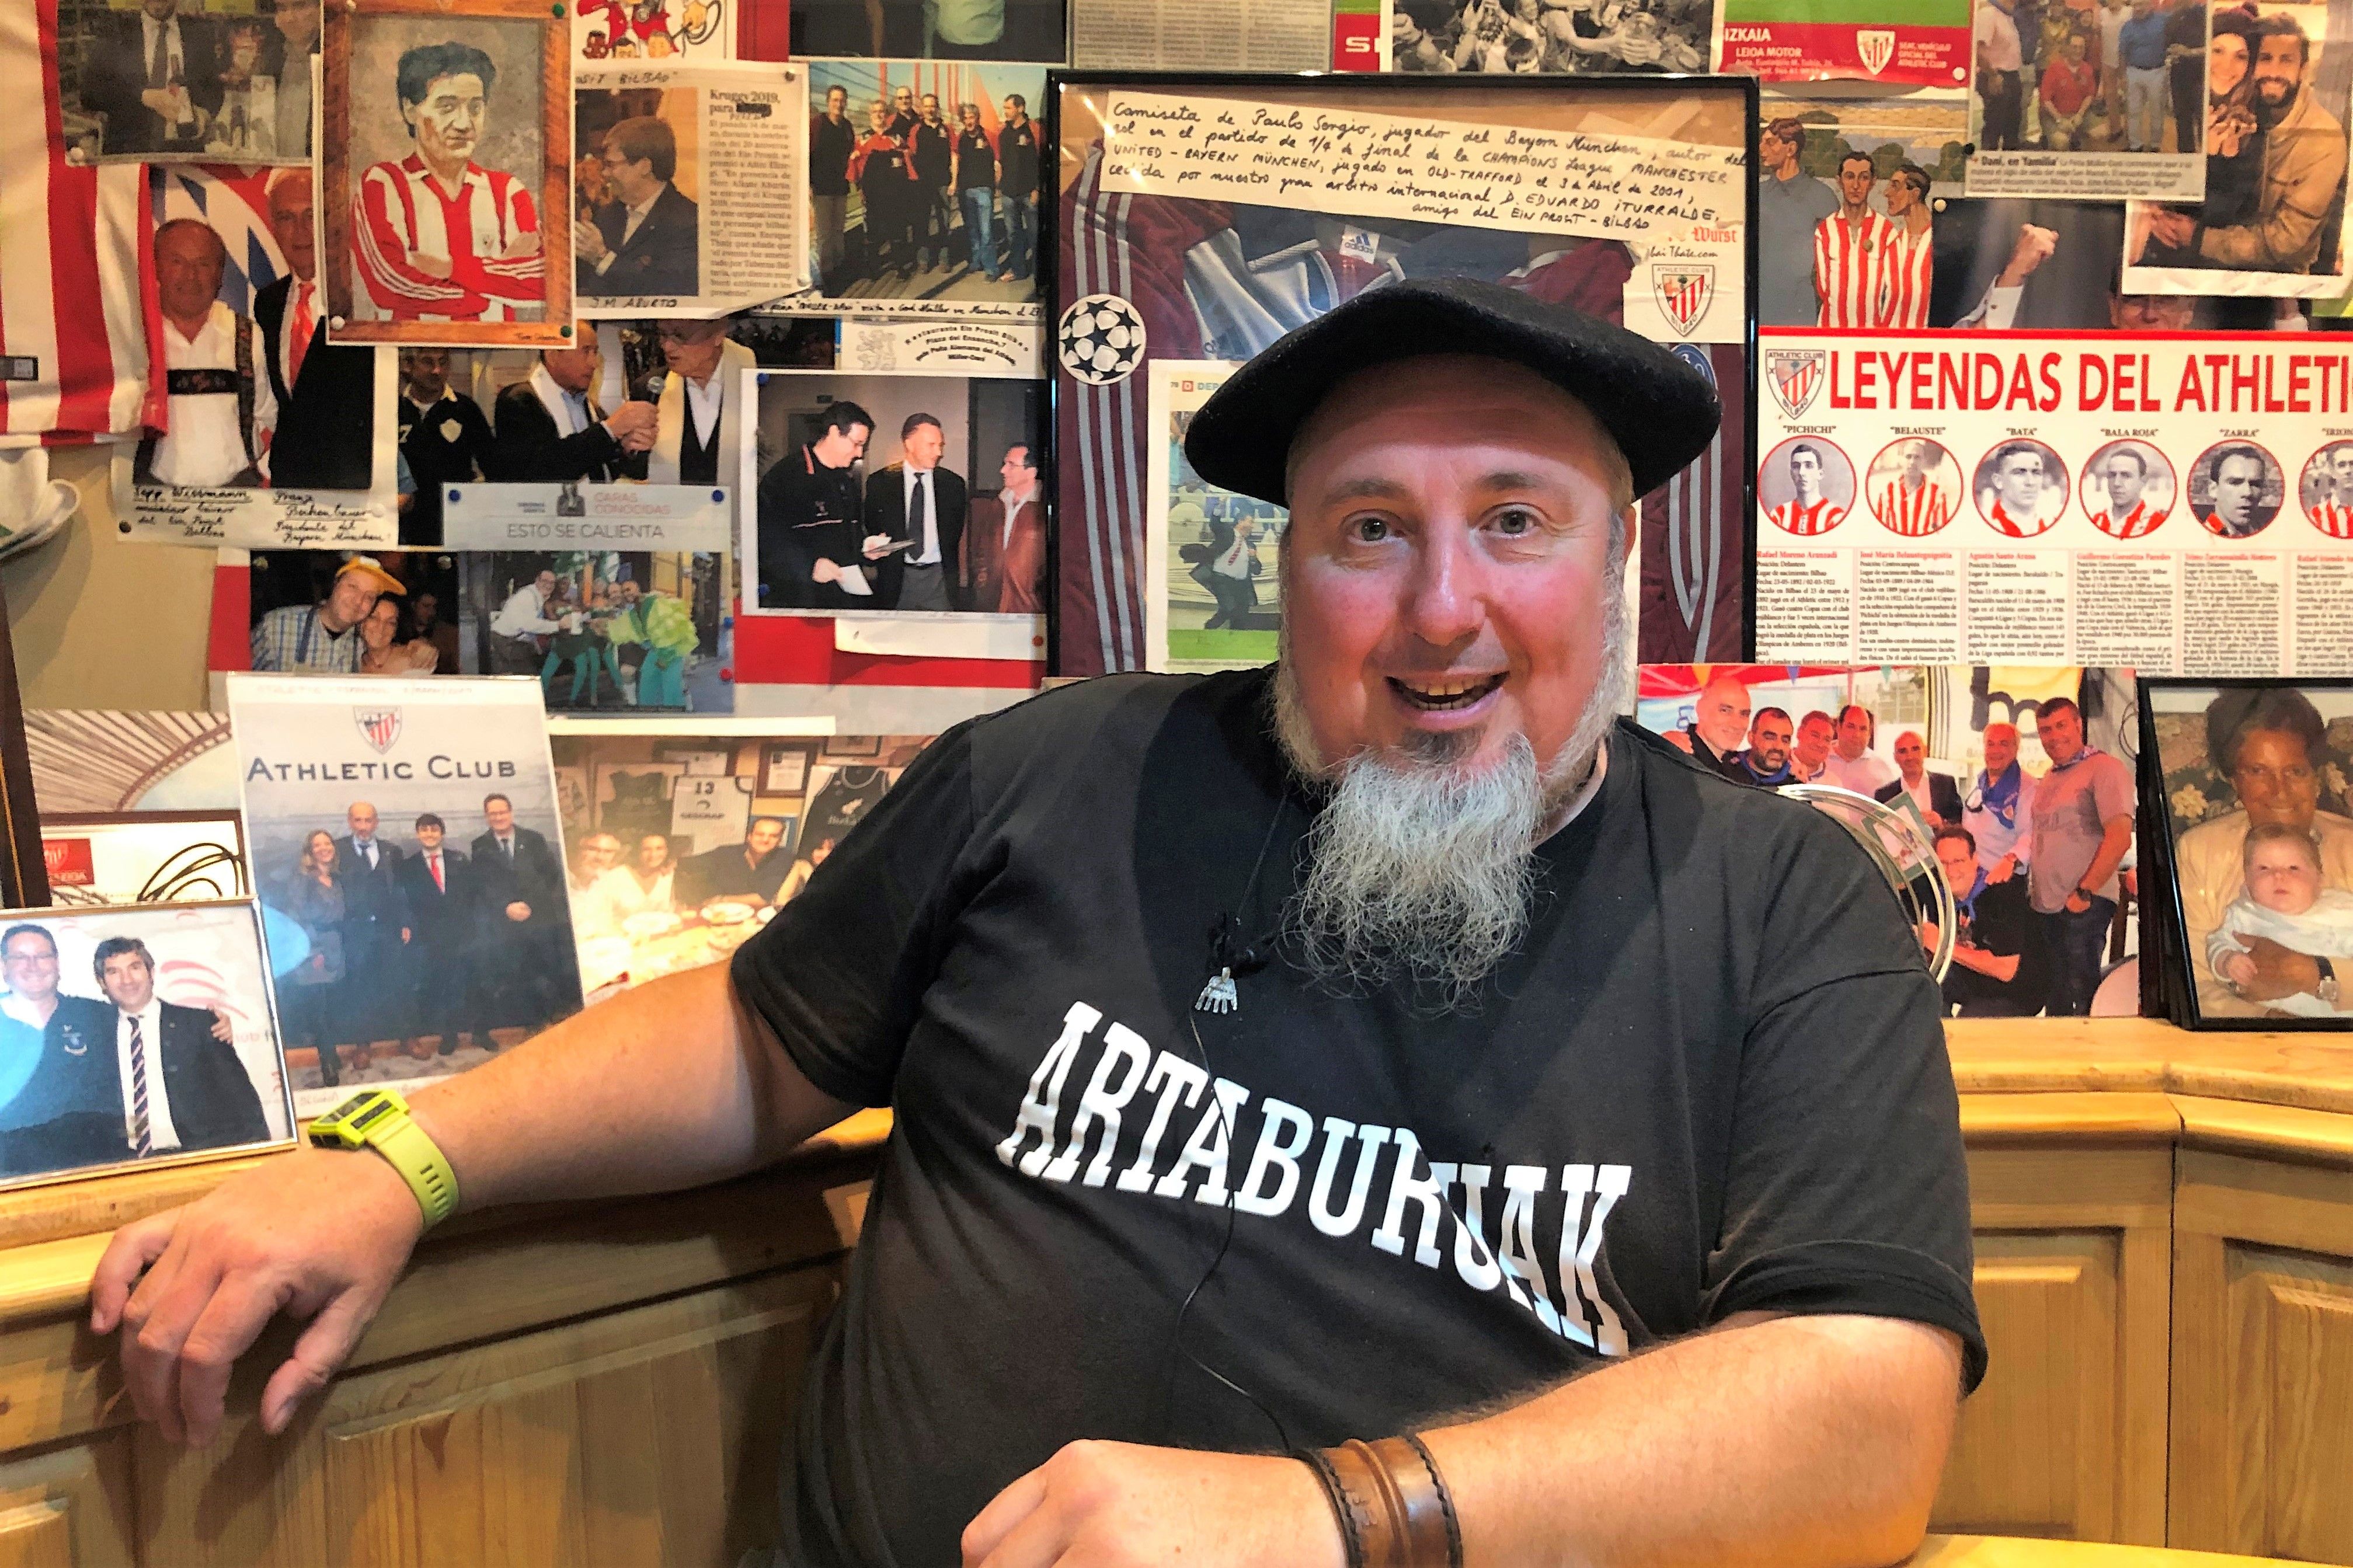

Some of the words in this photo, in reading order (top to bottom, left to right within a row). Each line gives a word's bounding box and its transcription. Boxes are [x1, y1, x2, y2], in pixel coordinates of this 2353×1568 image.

[1725, 28, 1771, 41] IZKAIA
[1345, 37, 1380, 53] S
[1736, 47, 1764, 57] LEIOA
[1767, 48, 1802, 57] MOTOR
[1113, 102, 1201, 122] Camiseta
[1217, 110, 1235, 124] de
[1252, 108, 1303, 130] Paulo
[1383, 124, 1450, 143] jugador
[1462, 129, 1489, 143] del
[1665, 146, 1711, 161] autor
[1150, 128, 1166, 137] en
[1179, 125, 1194, 138] el
[1205, 128, 1268, 148] partido
[1279, 134, 1296, 148] de
[1361, 143, 1412, 161] final
[1454, 147, 1469, 162] la
[1631, 163, 1728, 184] MANCHESTER
[1185, 148, 1239, 162] BAYERN
[1331, 157, 1387, 181] jugado
[1397, 166, 1414, 176] en
[1588, 179, 1621, 194] Abril
[1177, 170, 1202, 184] por
[1210, 169, 1269, 184] nuestro
[1279, 177, 1313, 194] gran
[1386, 180, 1491, 202] internacional
[1526, 193, 1600, 211] EDUARDO
[1412, 204, 1459, 219] amigo
[1473, 205, 1499, 219] del
[1691, 225, 1738, 243] Wurst
[1343, 241, 1375, 256] adidas
[1671, 314, 1697, 332] BILBAO
[925, 336, 946, 346] Plaza
[1767, 351, 1801, 360] ATHLETIC
[1804, 351, 1823, 360] CLUB
[1830, 350, 2062, 412] LEYENDAS
[2077, 353, 2161, 412] DEL
[2173, 354, 2353, 413] ATHLETI
[1783, 397, 1809, 416] BILBAO
[1783, 425, 1837, 434] "PICHICHI"
[1890, 426, 1947, 435] "BELAUSTE"
[2006, 427, 2038, 437] "BATA"
[2100, 428, 2129, 437] "BALA
[2219, 428, 2260, 437] "ZARRA"
[593, 492, 638, 503] CARAS
[594, 504, 671, 515] CONOCIDAS
[507, 522, 552, 539] ESTO
[555, 522, 576, 538] SE
[579, 522, 665, 539] CALIENTA
[246, 756, 414, 783] ATHLETIC
[427, 755, 517, 779] CLUB
[694, 781, 715, 795] 13
[995, 1001, 1632, 1356] ARTABURUAK
